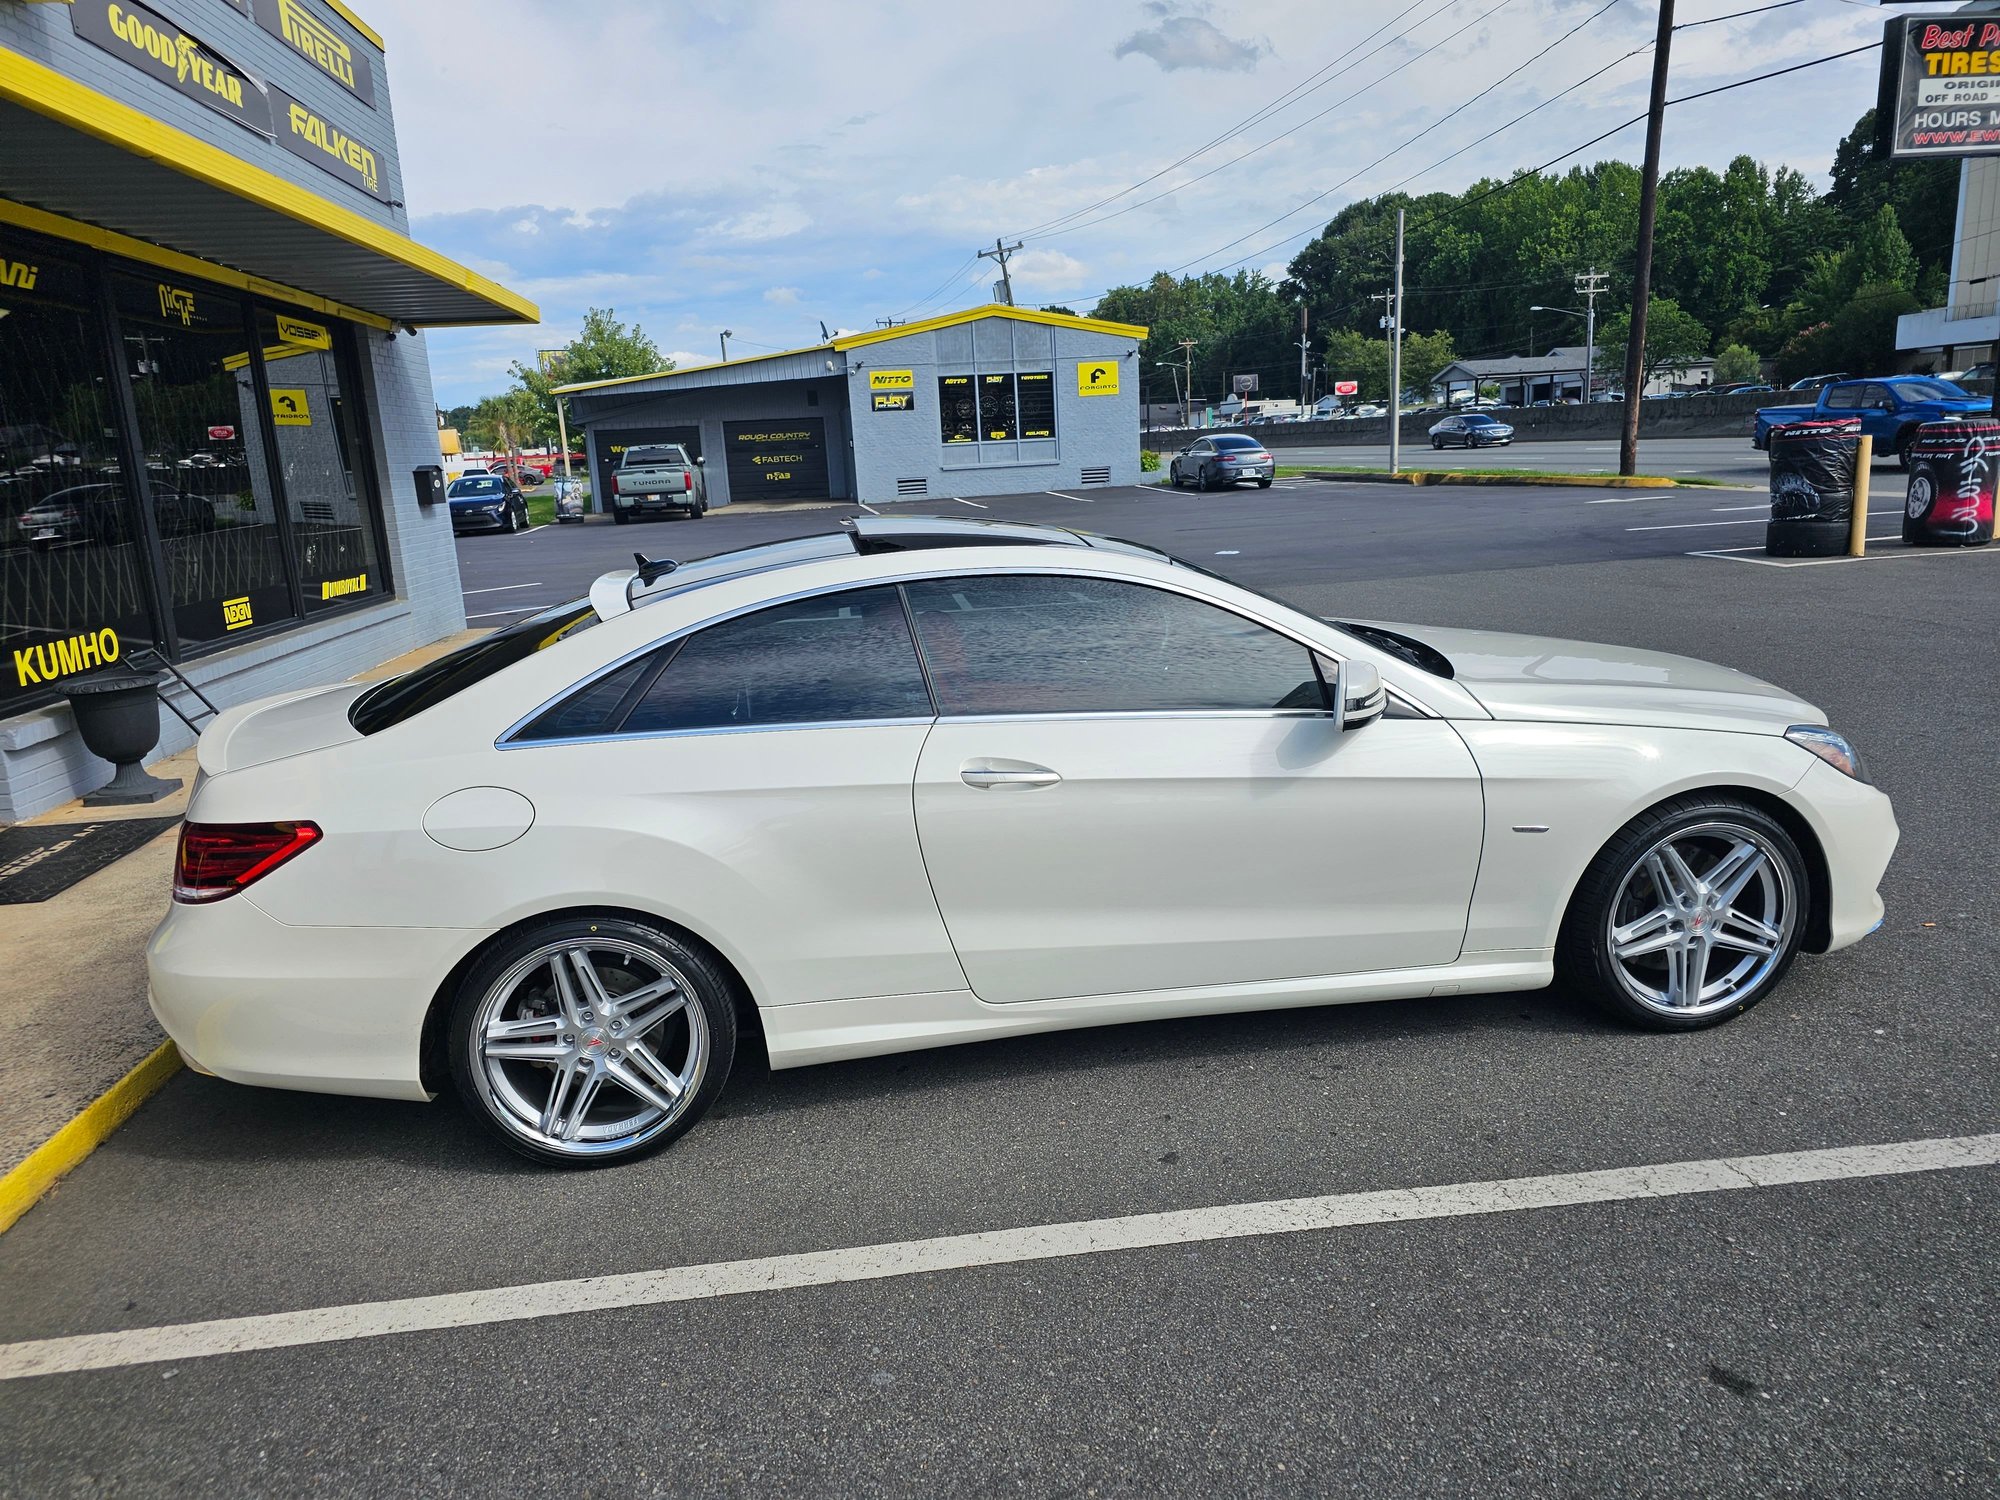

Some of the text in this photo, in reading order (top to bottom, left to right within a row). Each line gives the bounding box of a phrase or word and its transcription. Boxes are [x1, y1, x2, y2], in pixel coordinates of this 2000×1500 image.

[278, 0, 355, 89] PIRELLI
[1921, 24, 1975, 50] Best
[1924, 51, 2000, 76] TIRES
[1925, 92, 1989, 103] OFF ROAD
[1914, 110, 1981, 128] HOURS
[287, 103, 377, 181] FALKEN
[362, 174, 379, 193] TIRE
[872, 375, 912, 384] NITTO
[769, 431, 811, 439] COUNTRY
[1784, 427, 1834, 436] NITTO
[762, 454, 803, 463] FABTECH
[13, 627, 119, 687] KUMHO
